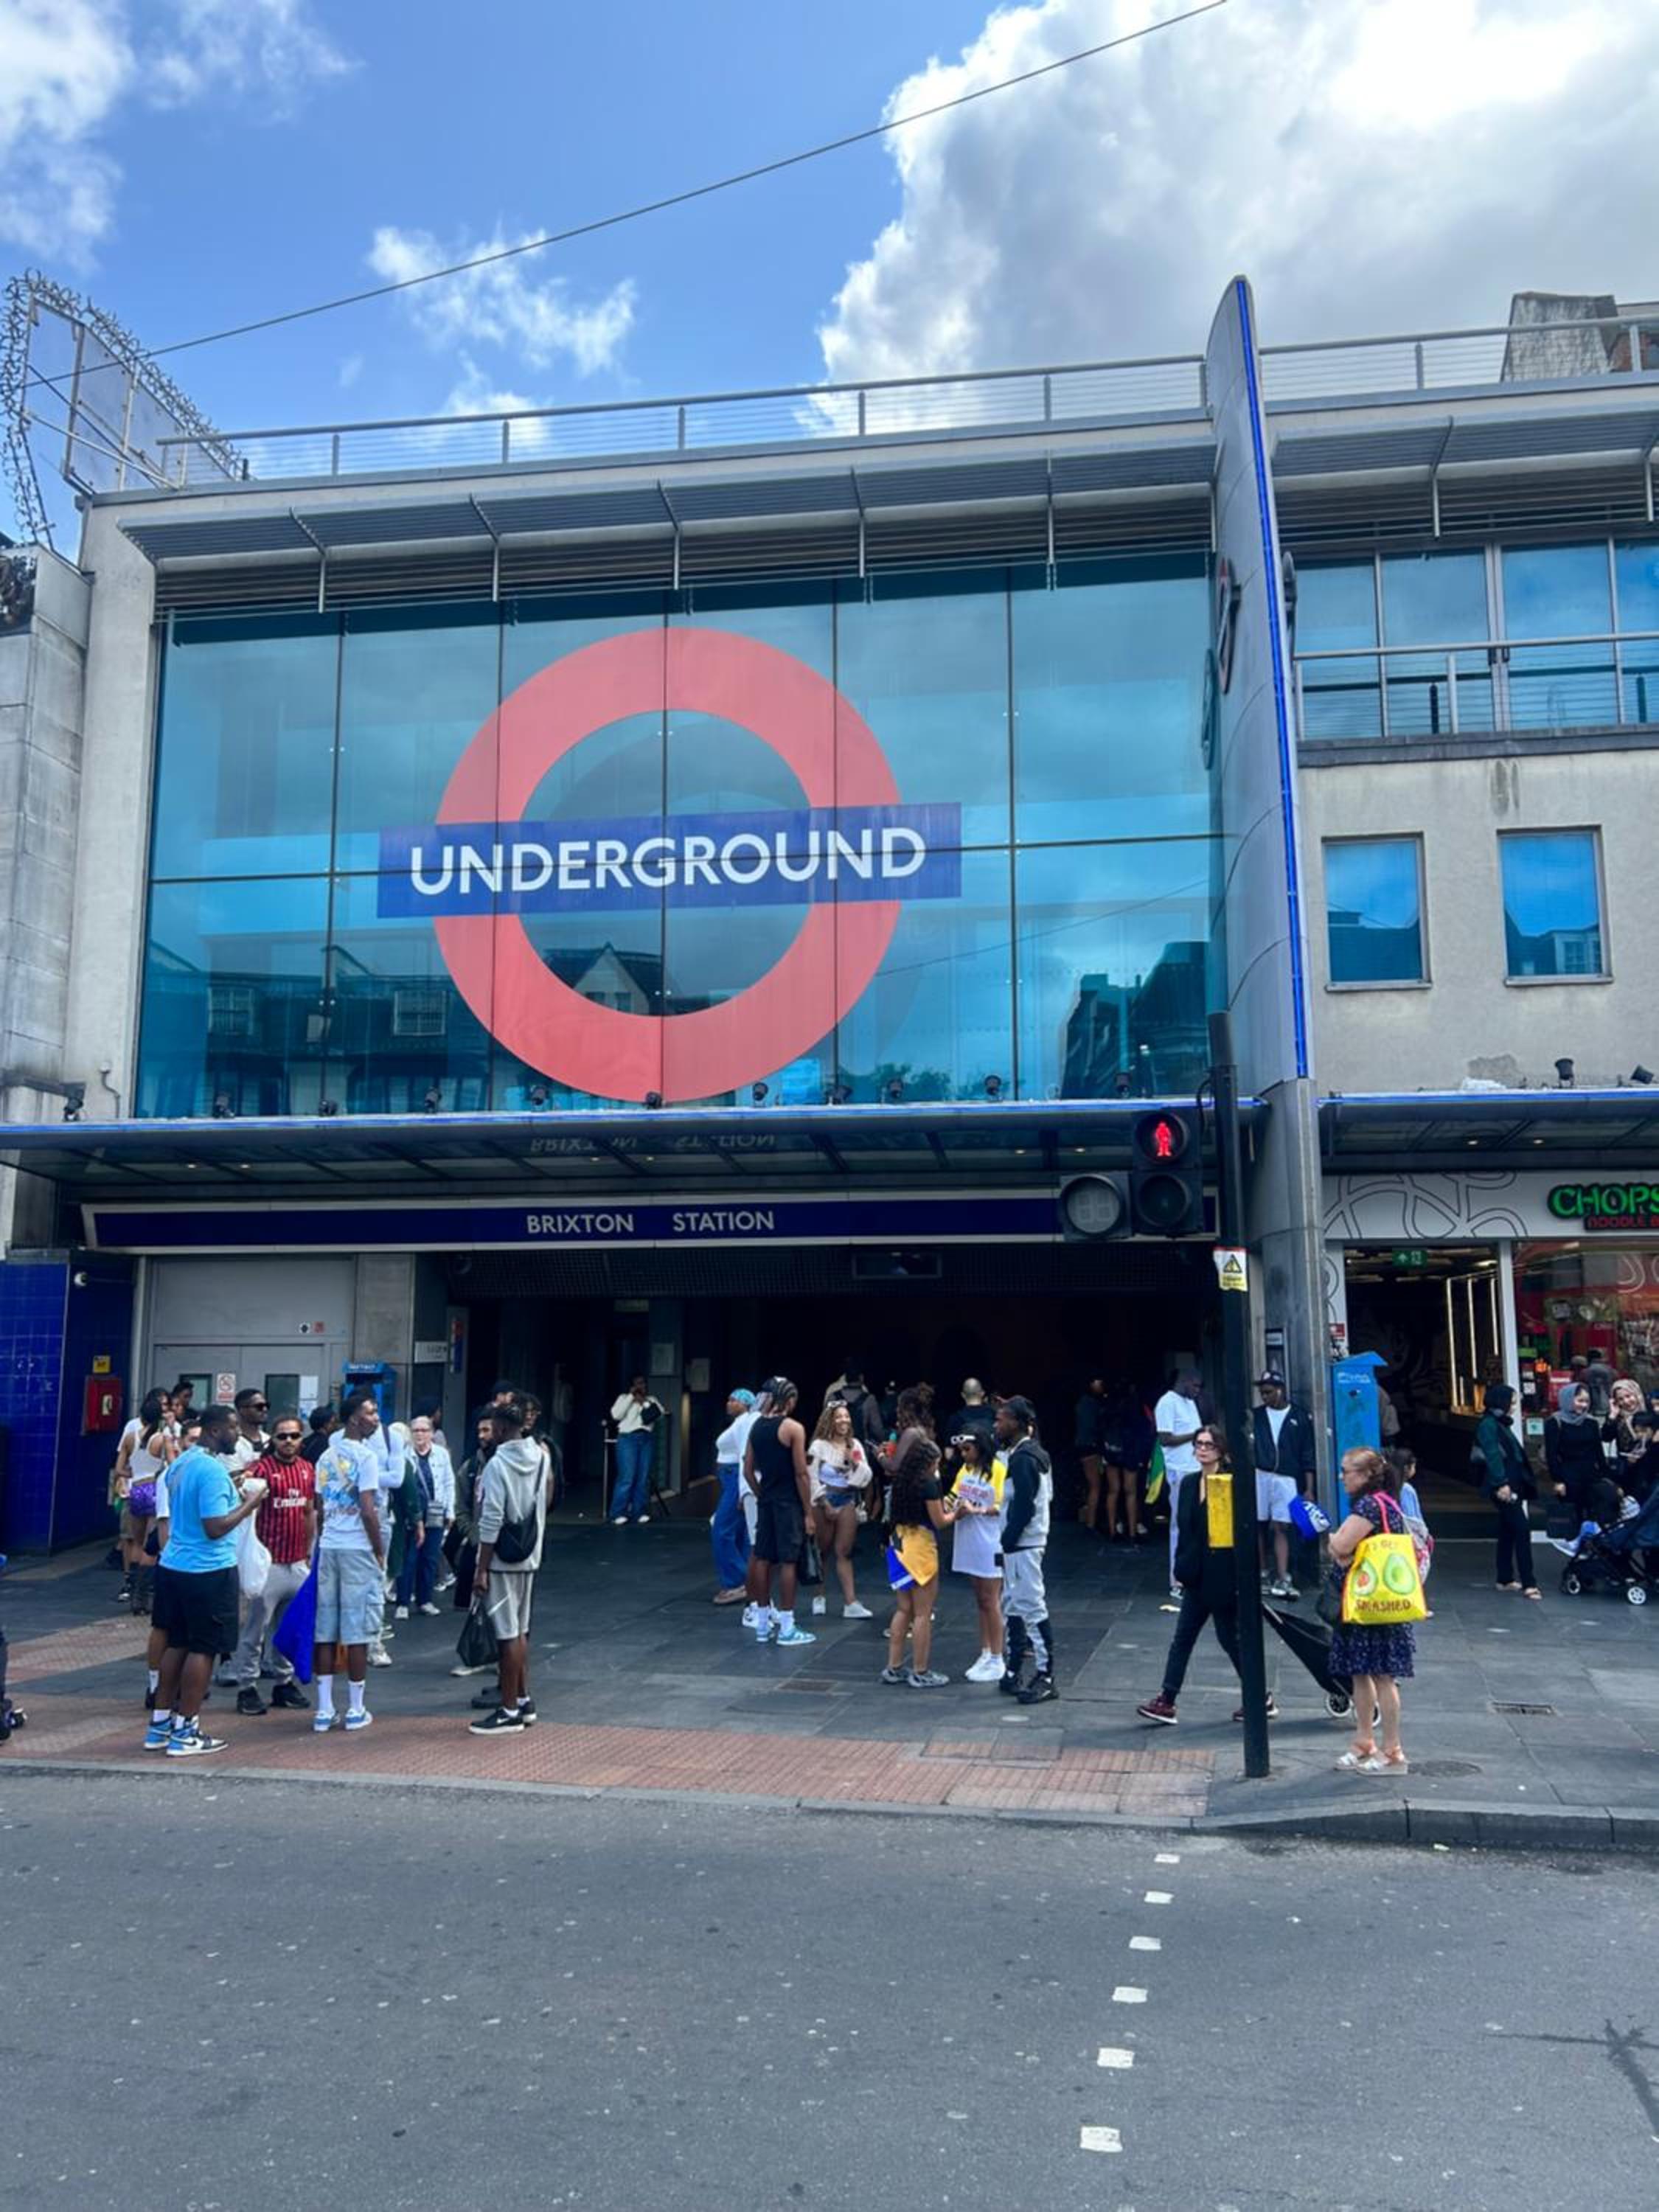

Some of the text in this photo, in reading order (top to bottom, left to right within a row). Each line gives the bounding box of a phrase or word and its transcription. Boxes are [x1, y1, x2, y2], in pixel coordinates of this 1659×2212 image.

[410, 828, 927, 895] UNDERGROUND
[526, 1211, 774, 1234] BRIXTON STATION
